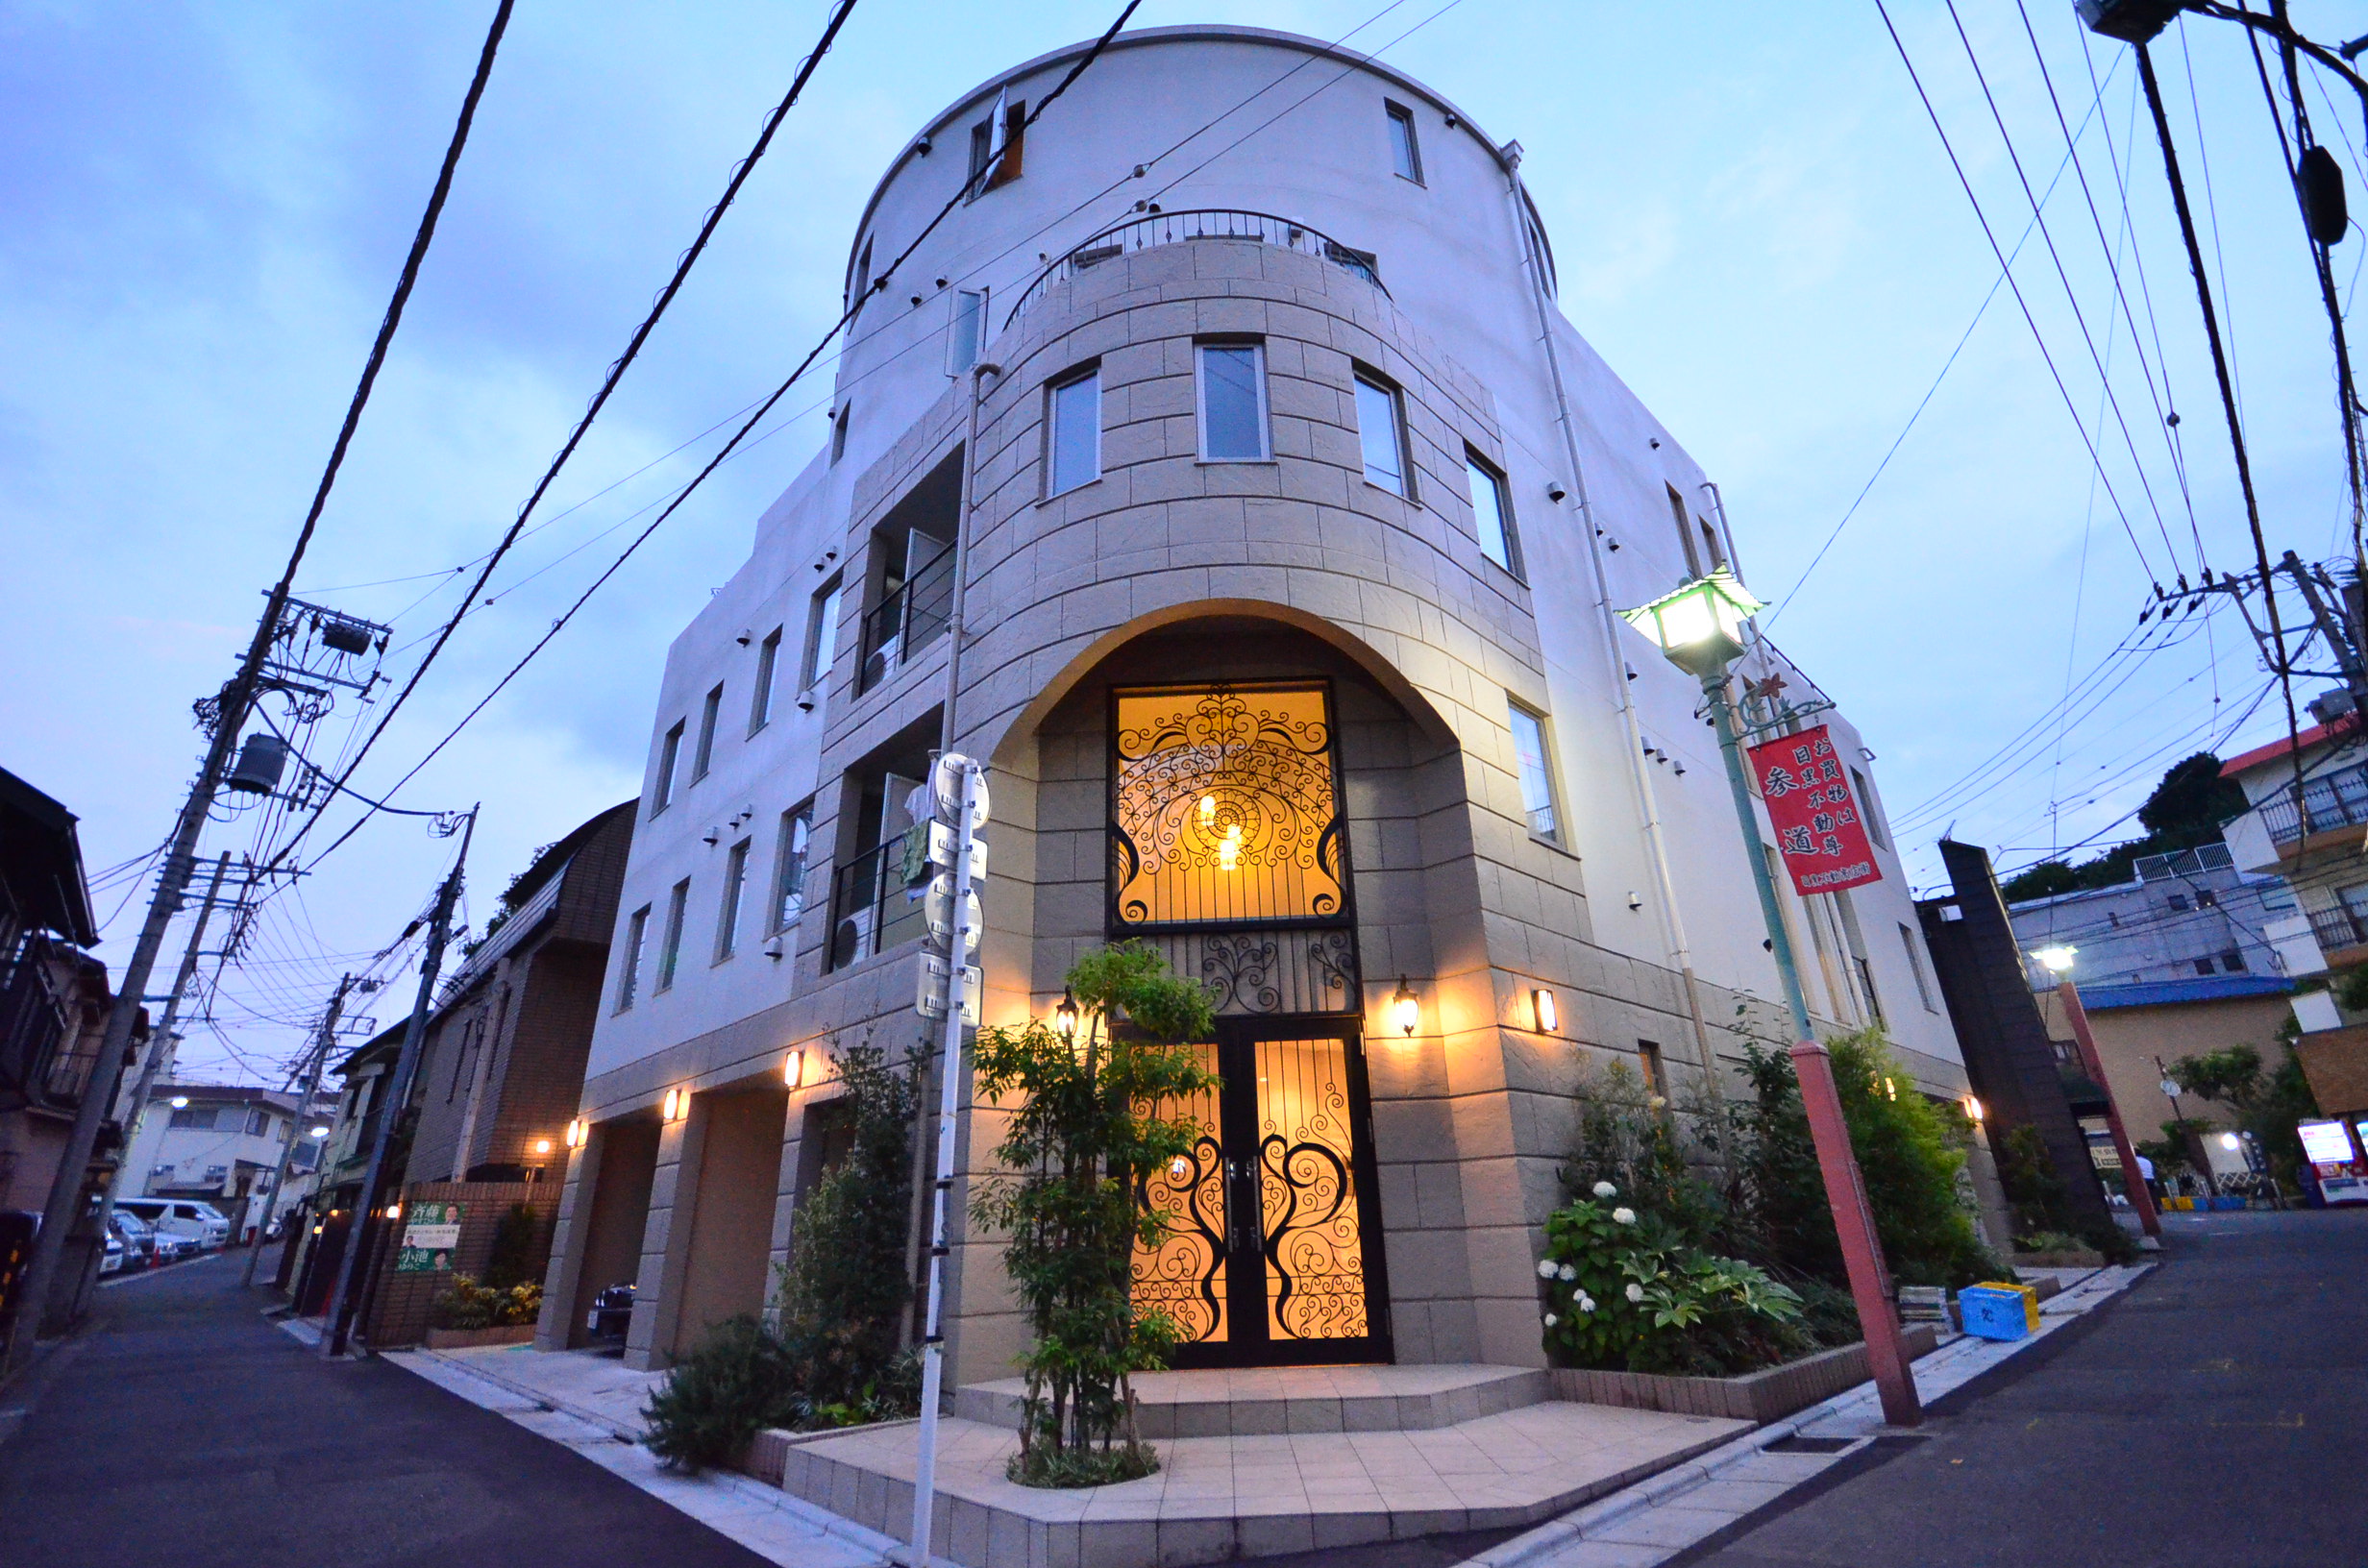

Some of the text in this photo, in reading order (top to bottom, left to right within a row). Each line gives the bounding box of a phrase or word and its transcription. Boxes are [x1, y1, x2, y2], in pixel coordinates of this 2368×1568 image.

[1765, 767, 1818, 855] 参道
[1793, 746, 1843, 856] 目黒不動尊
[1813, 738, 1856, 824] お買物は
